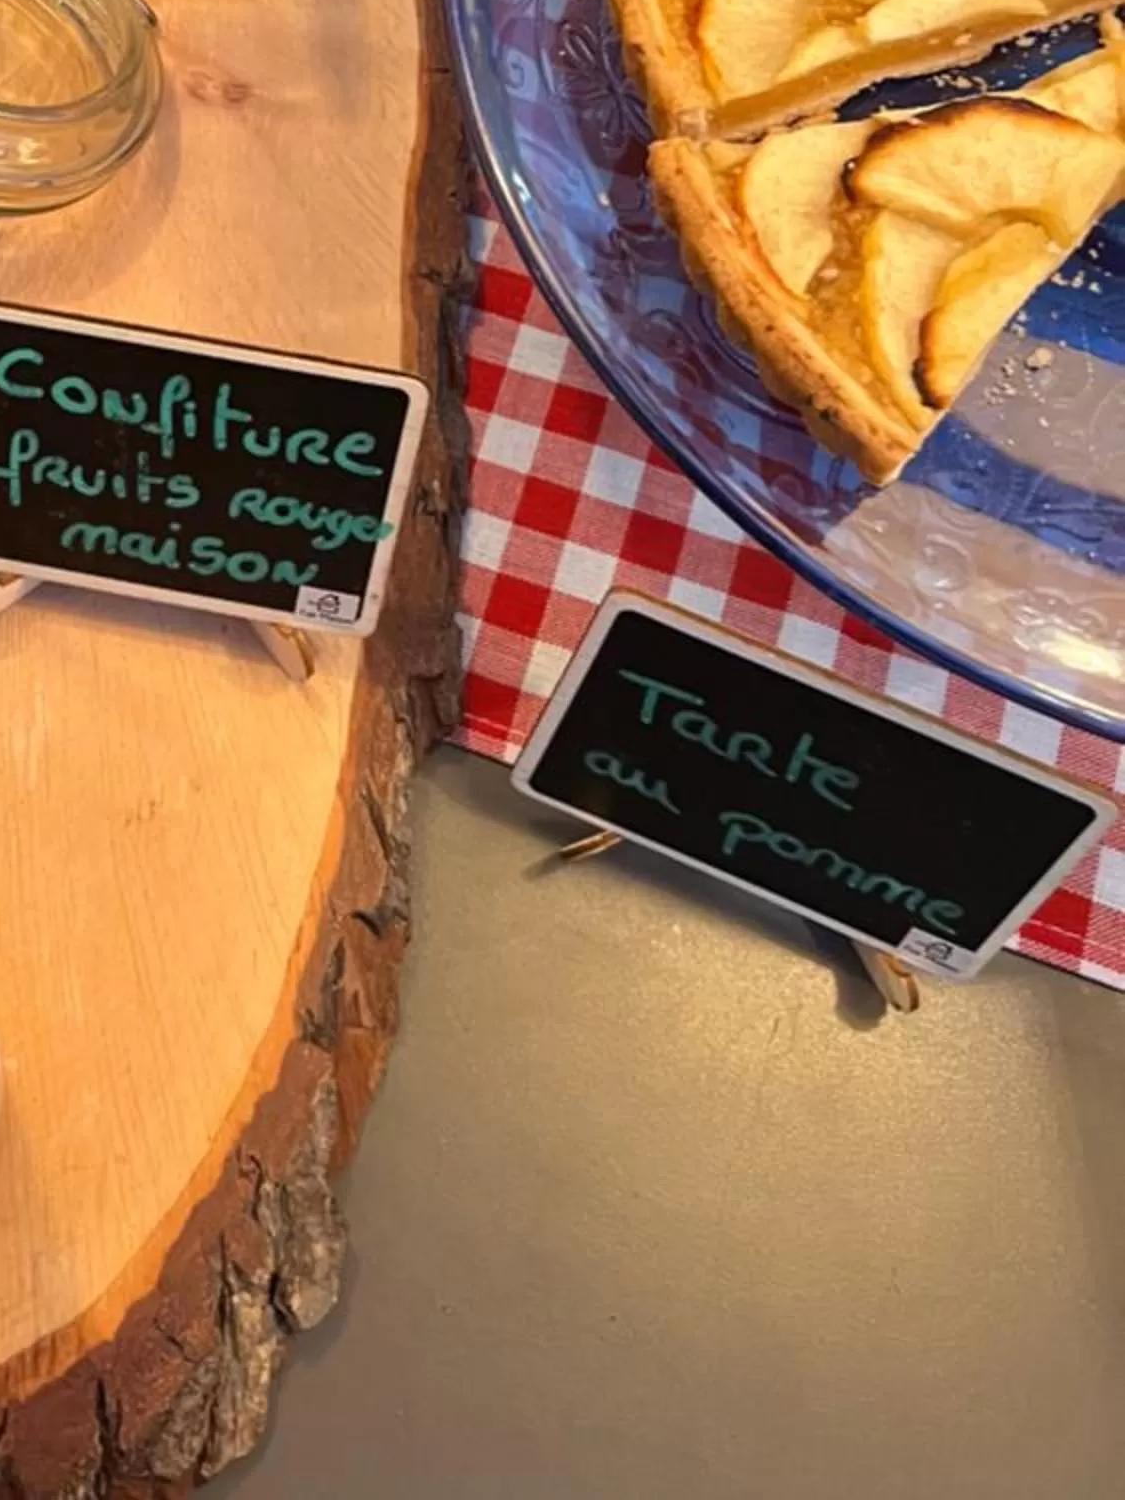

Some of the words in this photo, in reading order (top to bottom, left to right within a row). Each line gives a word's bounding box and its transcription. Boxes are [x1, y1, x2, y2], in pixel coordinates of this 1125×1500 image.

[61, 521, 318, 586] maison
[617, 669, 861, 812] Tarte
[583, 750, 681, 815] au
